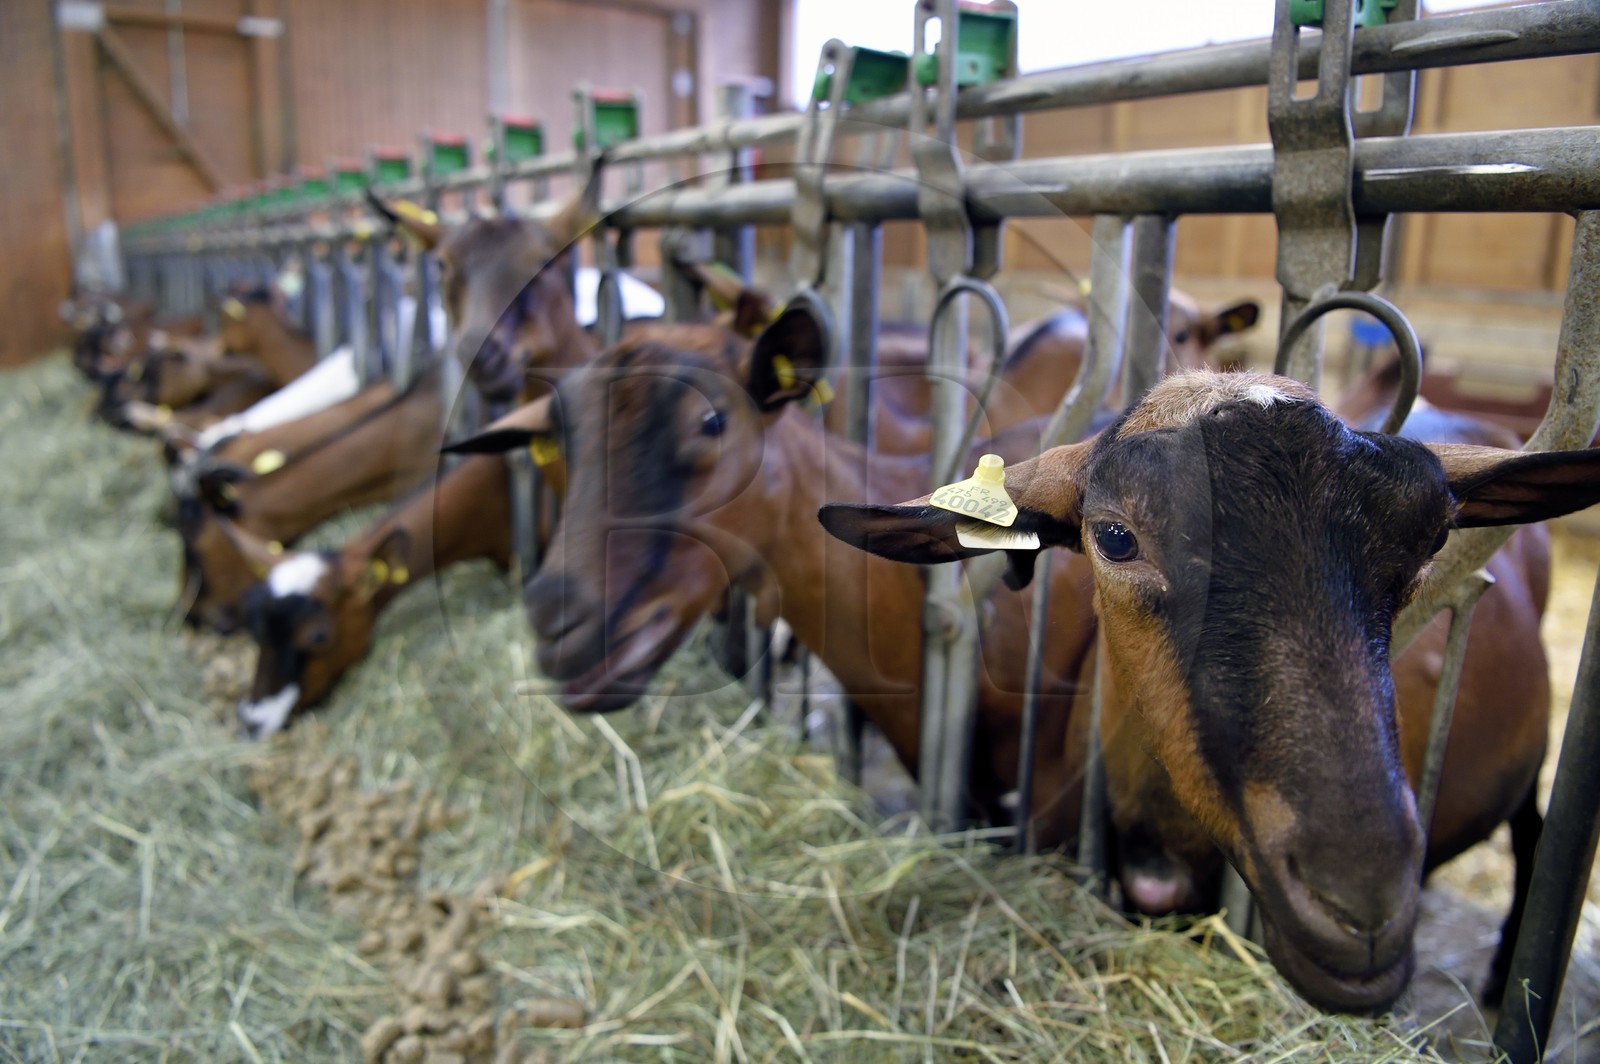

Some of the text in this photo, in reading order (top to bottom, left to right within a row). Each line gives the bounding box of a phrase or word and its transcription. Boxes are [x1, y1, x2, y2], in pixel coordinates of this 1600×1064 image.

[947, 486, 1007, 507] 475 499
[970, 486, 991, 495] FR
[933, 492, 1010, 523] 40042
